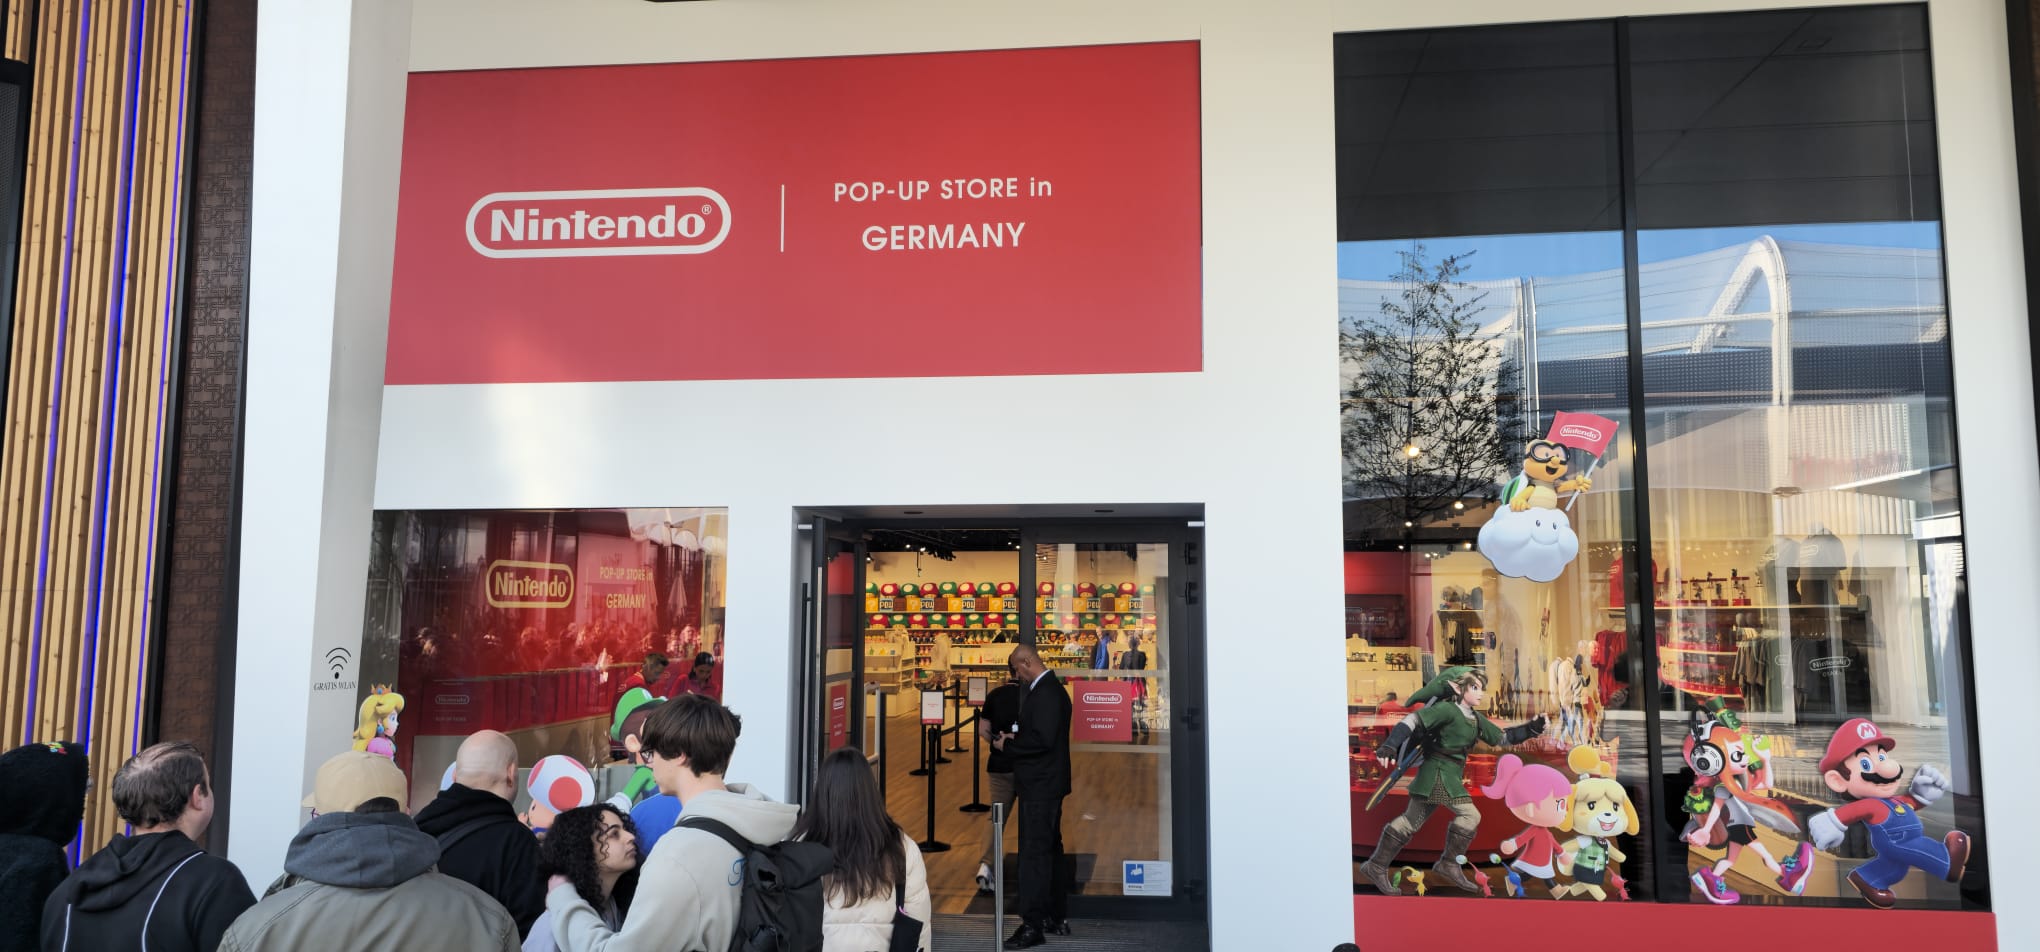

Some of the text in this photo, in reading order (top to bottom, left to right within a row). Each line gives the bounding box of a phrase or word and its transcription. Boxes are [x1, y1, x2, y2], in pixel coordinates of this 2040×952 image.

[834, 176, 1052, 202] POP-UP STORE in
[862, 222, 1026, 251] GERMANY
[1562, 427, 1598, 439] Nintendo
[599, 566, 625, 580] POP-UP
[626, 567, 645, 581] STORE
[606, 593, 646, 609] GERMANY
[313, 681, 356, 691] GRATIS WLAN
